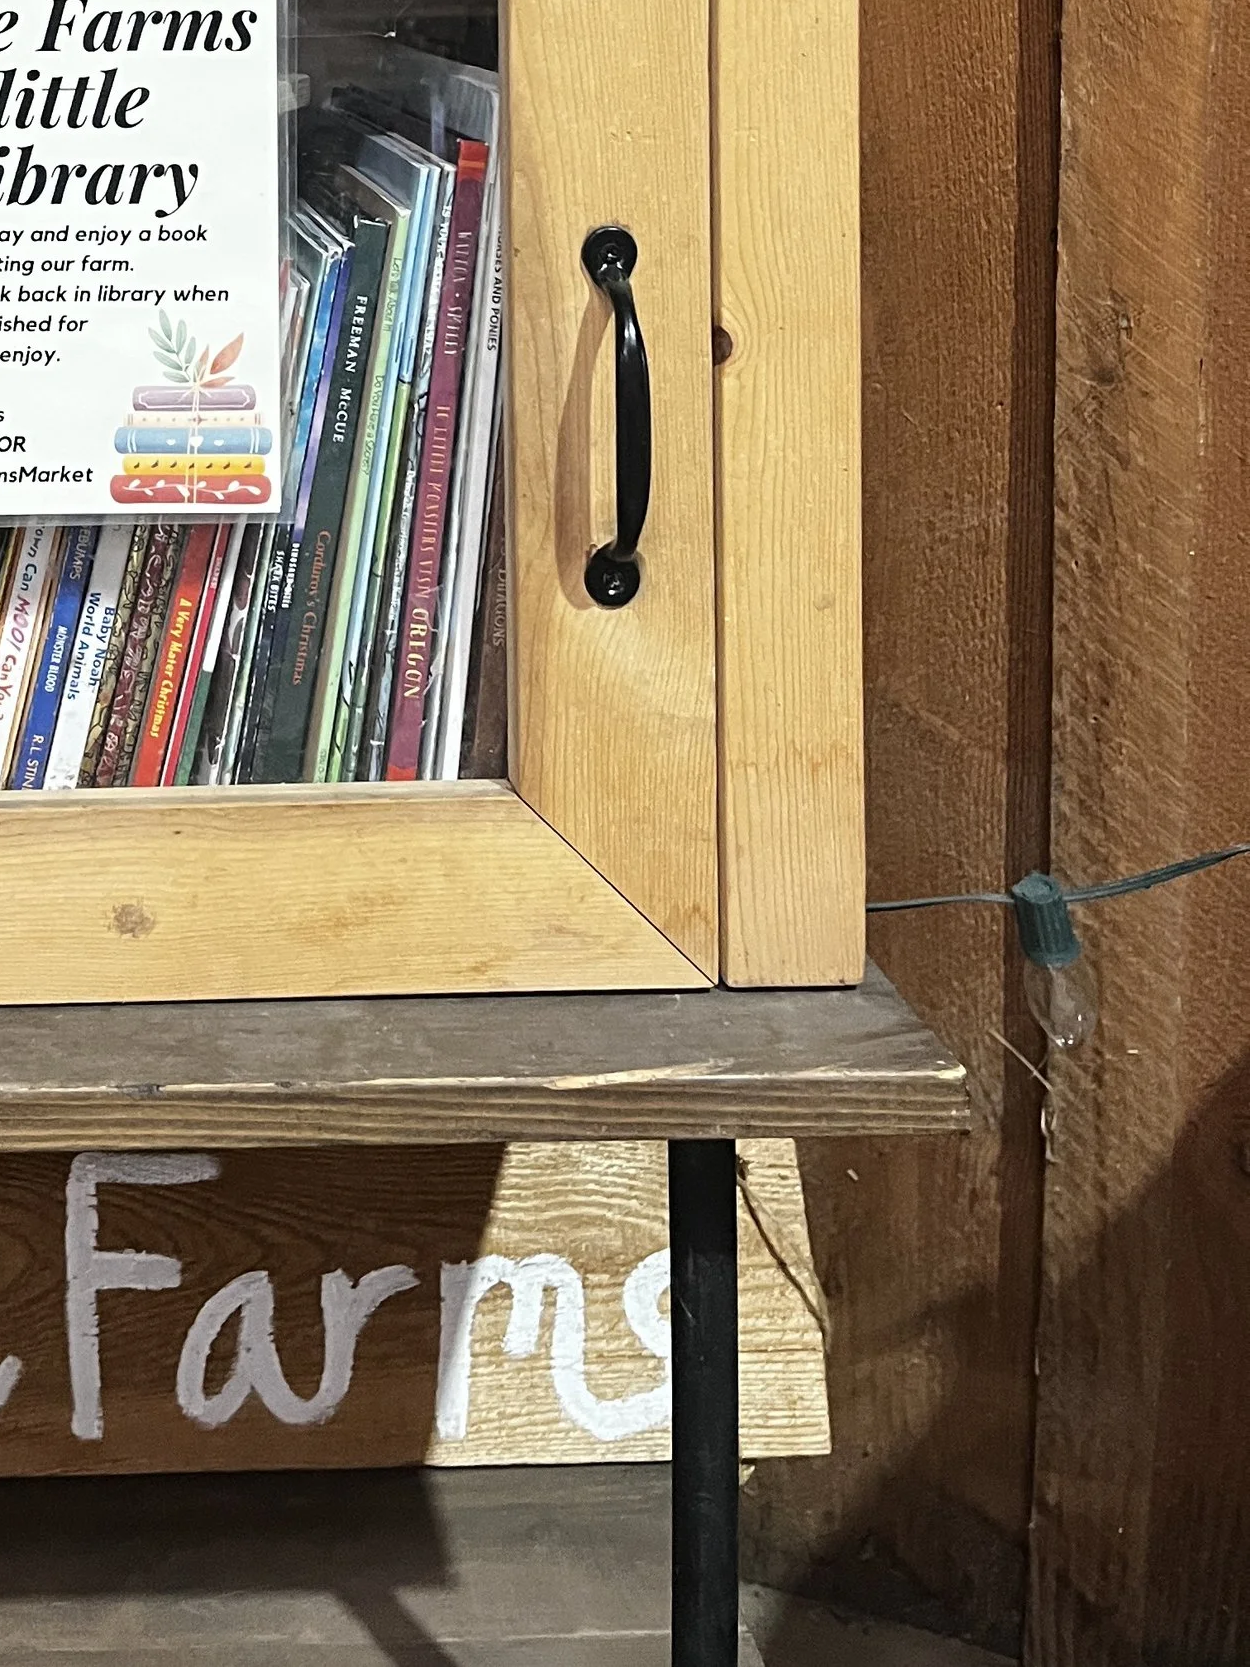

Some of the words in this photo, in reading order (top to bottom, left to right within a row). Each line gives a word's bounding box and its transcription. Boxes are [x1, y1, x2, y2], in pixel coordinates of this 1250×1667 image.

[31, 226, 68, 242] and
[75, 227, 131, 245] enjoy
[139, 230, 151, 242] a
[158, 225, 208, 242] book
[41, 259, 75, 272] our
[81, 255, 134, 272] farm.
[18, 285, 67, 302] back
[74, 287, 91, 302] in
[98, 285, 165, 305] library
[174, 285, 229, 302] when
[492, 277, 502, 304] AND
[58, 315, 88, 332] for
[345, 295, 368, 373] FREEMAN
[487, 307, 500, 351] PONIES
[0, 347, 61, 366] enjoy.
[333, 388, 352, 443] McCUE
[28, 528, 44, 557] own
[70, 527, 91, 580] EBUMPS
[20, 563, 37, 591] Can
[82, 592, 101, 636] World
[180, 598, 192, 607] A
[268, 584, 279, 613] BITES
[5, 595, 30, 650] MOO!
[100, 606, 115, 644] Baby
[170, 608, 190, 637] Very
[51, 625, 68, 664] MONSTER
[165, 642, 182, 678] Mater
[293, 612, 317, 685] Christmas
[403, 607, 429, 699] OREGON
[0, 654, 17, 681] Can
[45, 663, 61, 693] BLOOD
[67, 640, 89, 700] Animals
[88, 646, 106, 686] Noah
[150, 676, 174, 738] Christmas
[22, 758, 39, 790] STIN
